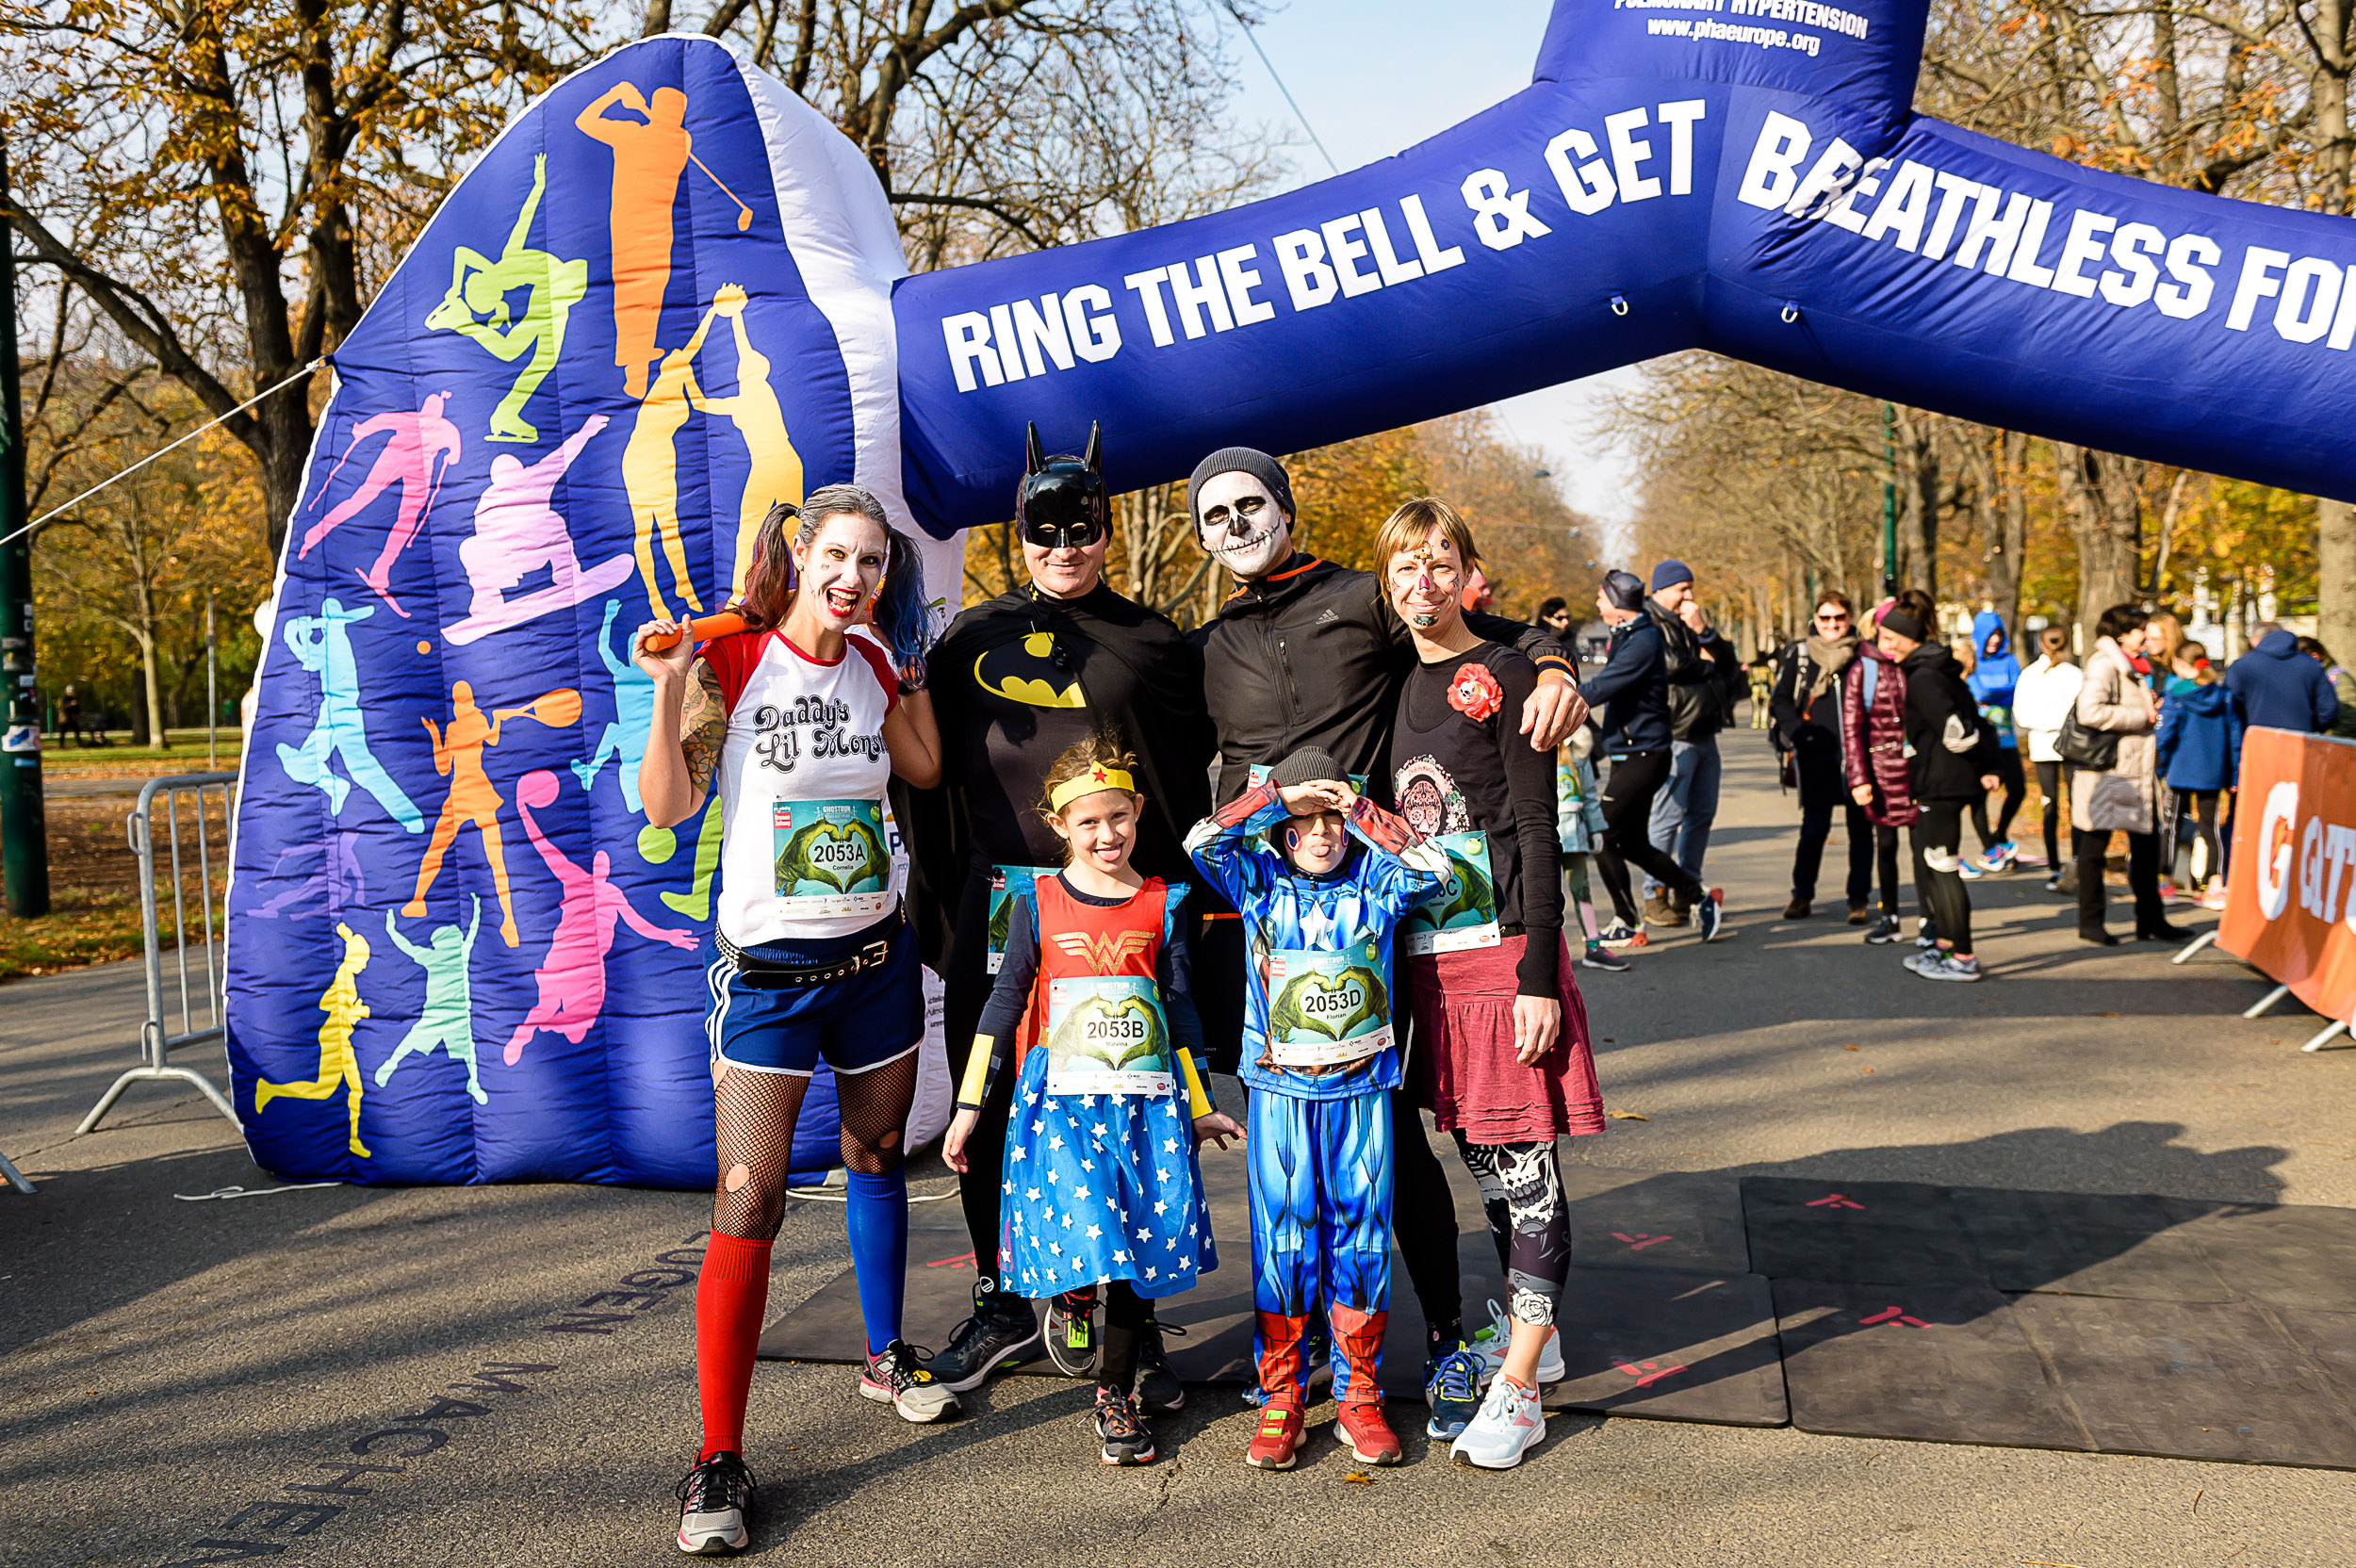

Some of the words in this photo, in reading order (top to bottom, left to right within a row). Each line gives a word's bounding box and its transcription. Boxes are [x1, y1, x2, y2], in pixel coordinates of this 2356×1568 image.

[1647, 18, 1821, 57] www.phaeurope.org
[1730, 0, 1869, 40] HYPERTENSION
[941, 284, 1122, 393] RING
[1124, 243, 1276, 348] THE
[1272, 193, 1466, 312] BELL
[1460, 168, 1552, 252] &
[1544, 99, 1706, 216] GET
[1737, 109, 2221, 319] BREATHLESS
[754, 694, 851, 735] Daddy's
[755, 728, 802, 774] Lil
[811, 727, 889, 763] Monst
[813, 843, 866, 862] 2053A
[1304, 988, 1362, 1013] 2053D
[1087, 1021, 1144, 1038] 2053B
